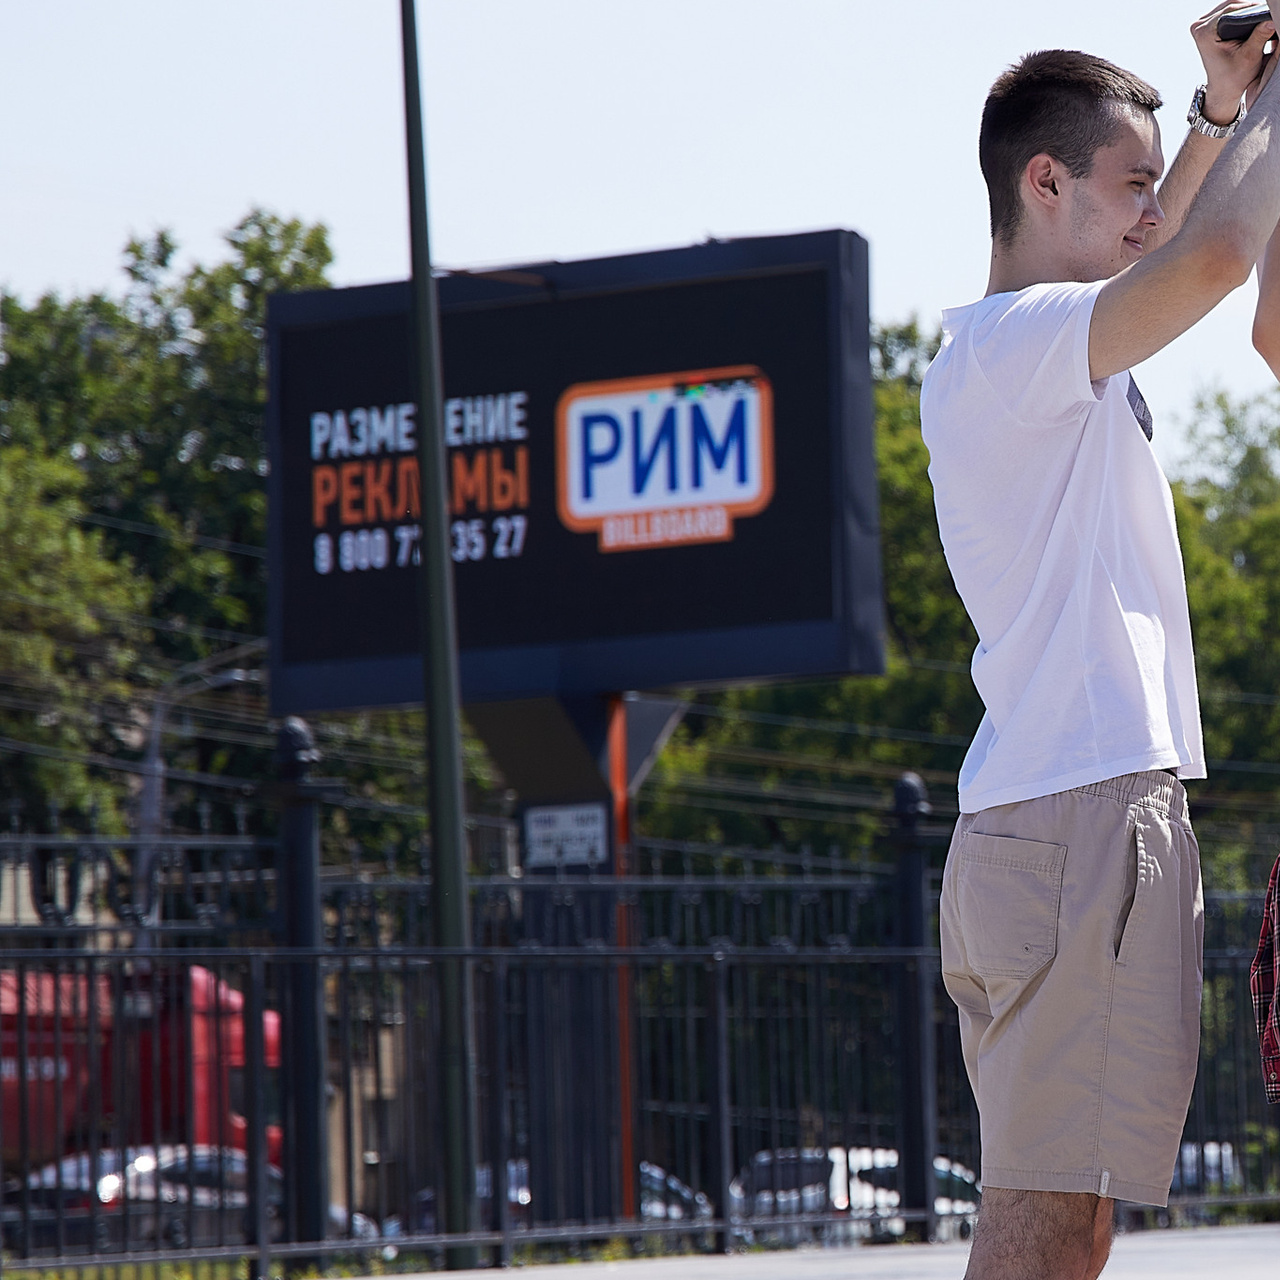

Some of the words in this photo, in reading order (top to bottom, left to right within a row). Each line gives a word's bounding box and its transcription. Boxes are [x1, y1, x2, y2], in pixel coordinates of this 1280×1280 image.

[310, 391, 529, 461] РАЗМЕЕНИЕ
[580, 398, 748, 502] РИМ
[312, 444, 530, 529] РЕКЛМЫ
[313, 532, 334, 576] 8
[338, 527, 389, 573] 800
[450, 519, 487, 563] 35
[492, 515, 528, 559] 27
